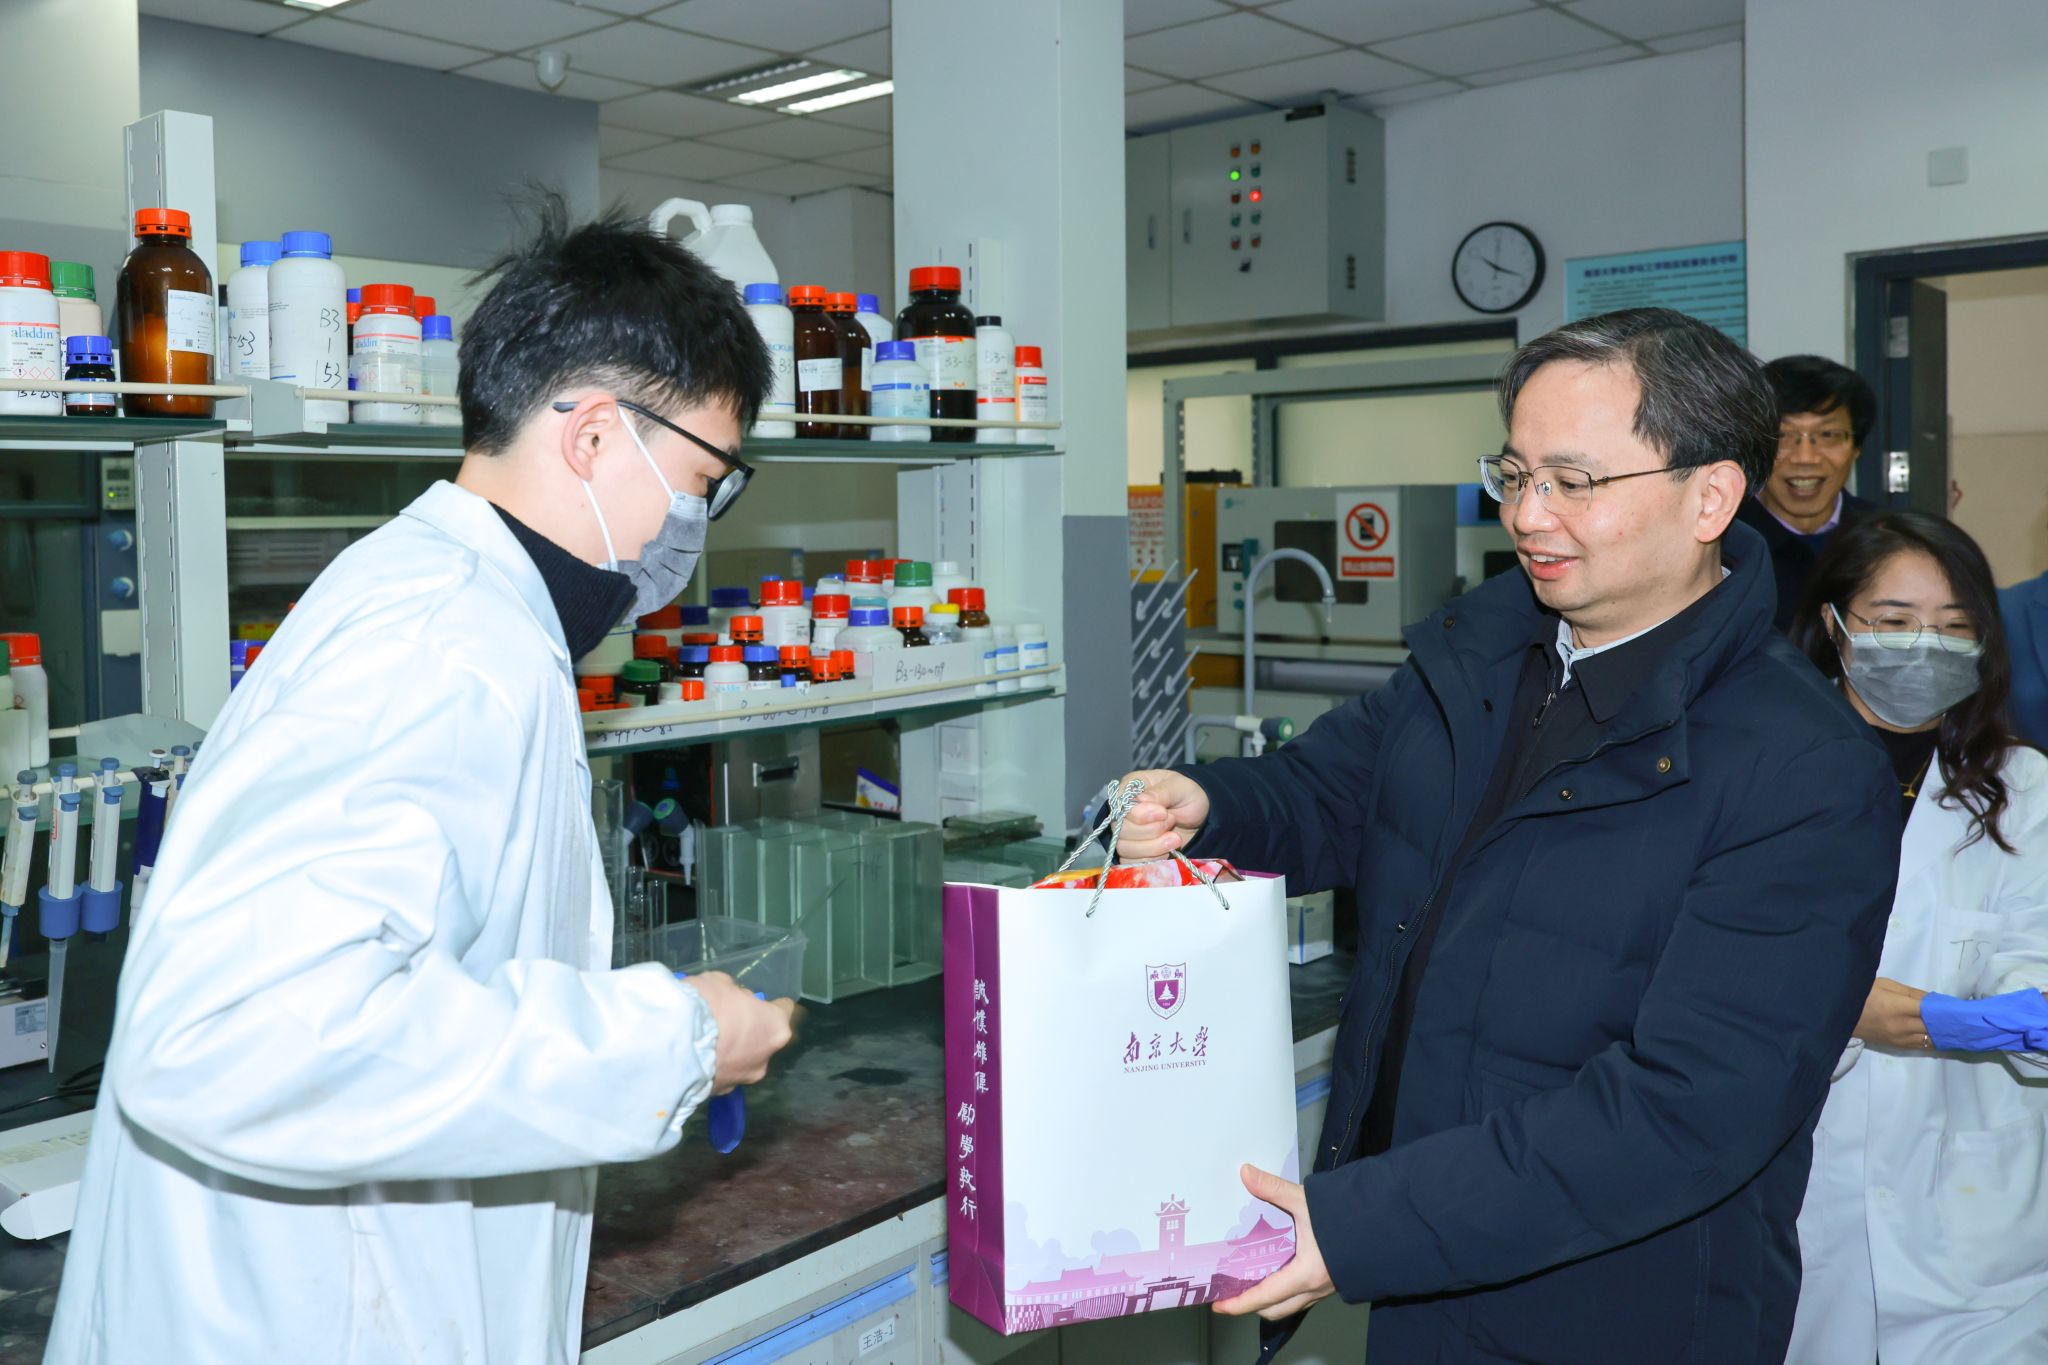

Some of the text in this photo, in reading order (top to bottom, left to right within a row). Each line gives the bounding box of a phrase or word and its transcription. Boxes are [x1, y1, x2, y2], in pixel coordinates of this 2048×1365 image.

[320, 307, 341, 333] B3
[11, 326, 54, 340] aladdin
[1123, 1058, 1208, 1075] NANJING UNIVERSITY
